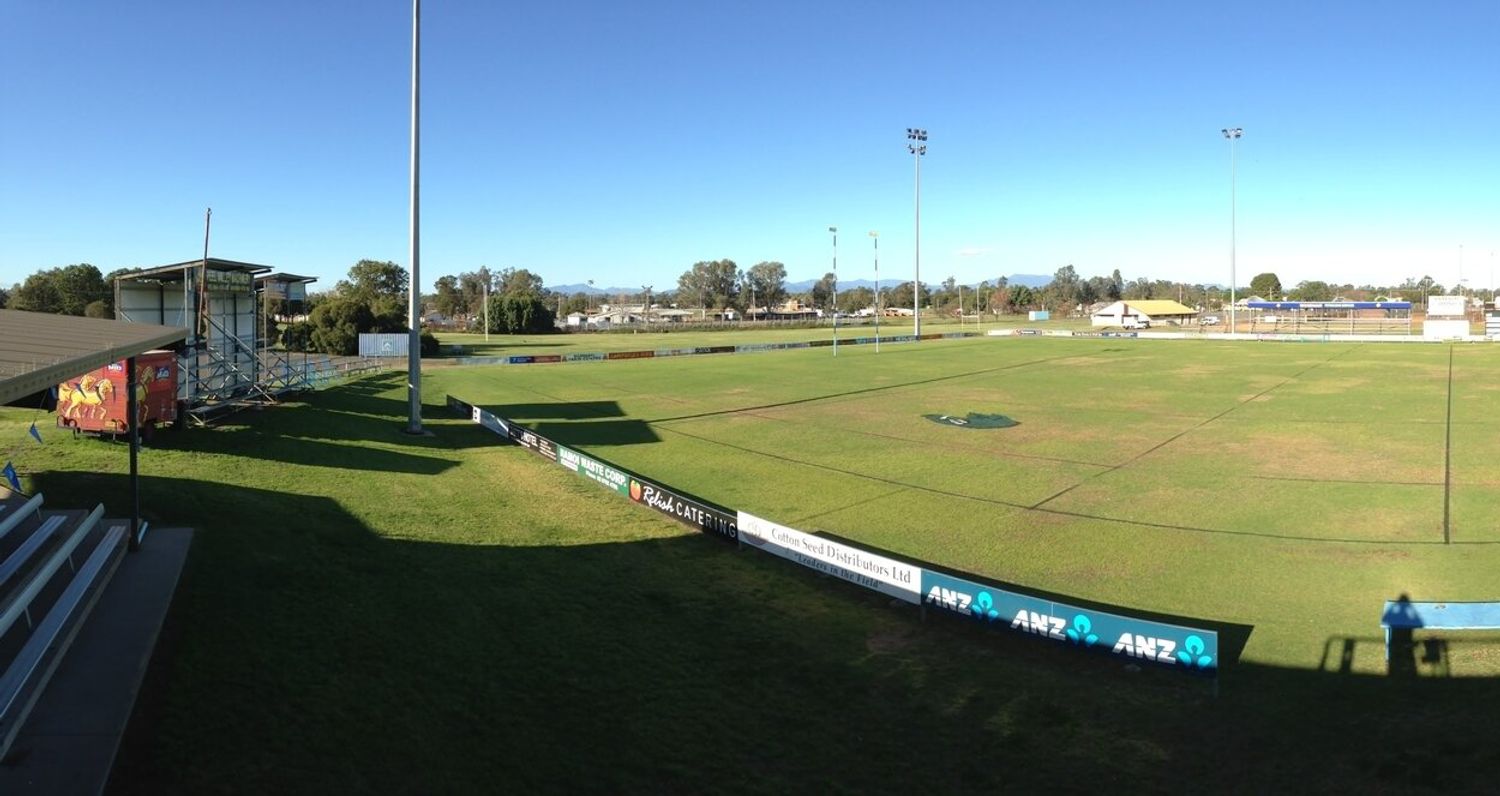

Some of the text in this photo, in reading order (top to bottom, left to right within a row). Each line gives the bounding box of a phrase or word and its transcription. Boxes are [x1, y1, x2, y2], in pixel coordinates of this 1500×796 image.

[643, 485, 737, 538] Relish CATERING
[771, 527, 912, 585] Cotton Seed Distributors Ltd
[926, 585, 973, 616] ANZ
[1010, 609, 1067, 641] ANZ
[1112, 632, 1178, 665] ANZ
